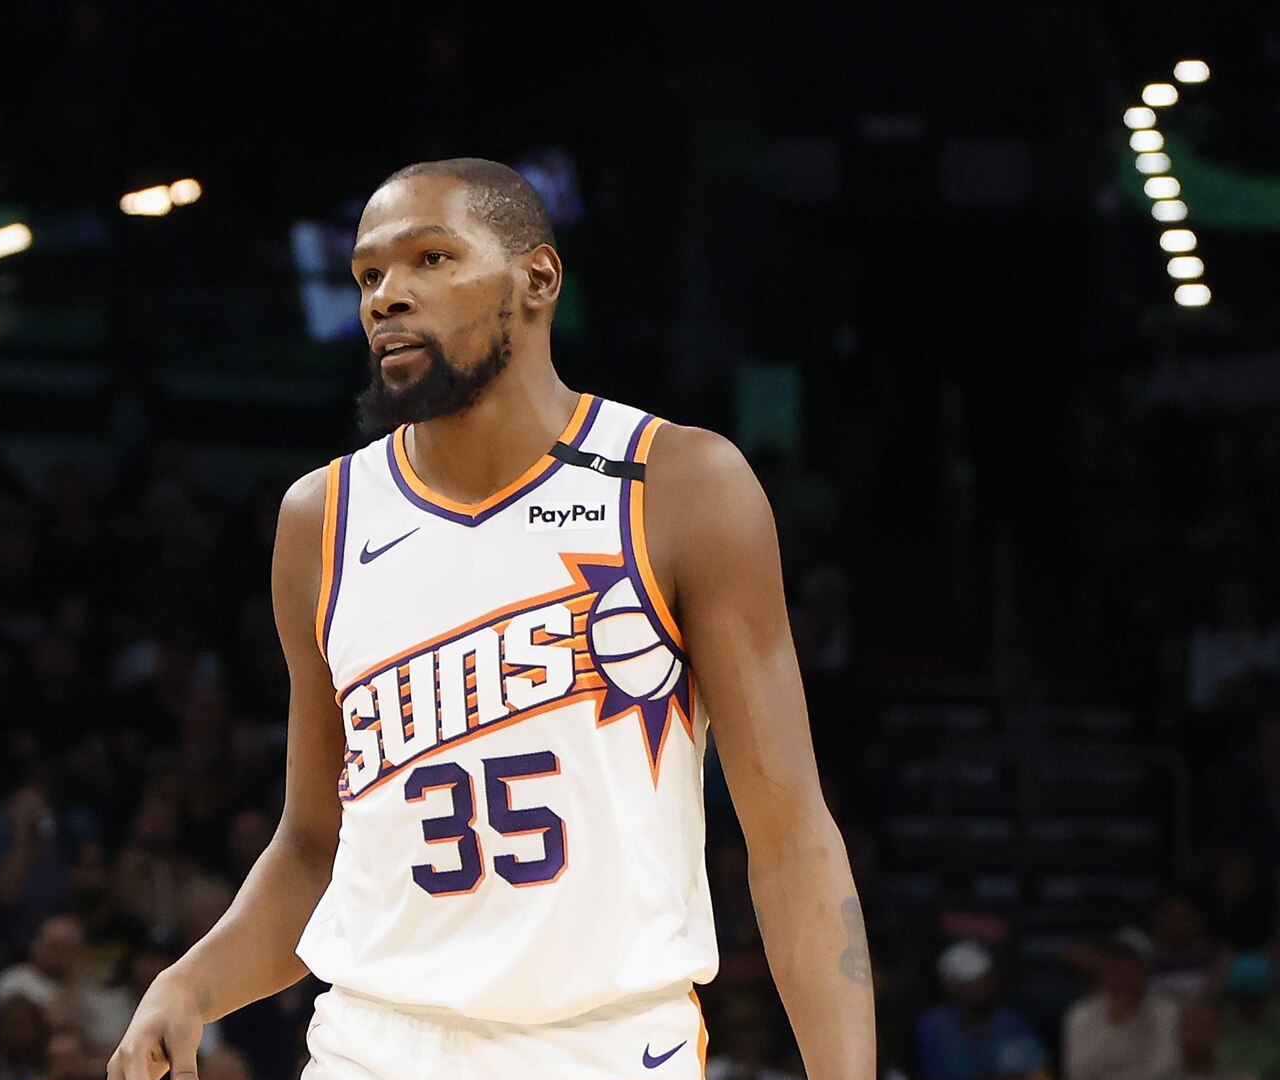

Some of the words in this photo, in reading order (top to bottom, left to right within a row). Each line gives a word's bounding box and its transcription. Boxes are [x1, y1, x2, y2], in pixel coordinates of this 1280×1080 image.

[590, 456, 605, 472] AL
[529, 504, 605, 527] PayPal
[342, 602, 575, 795] SUNS
[404, 750, 568, 898] 35
